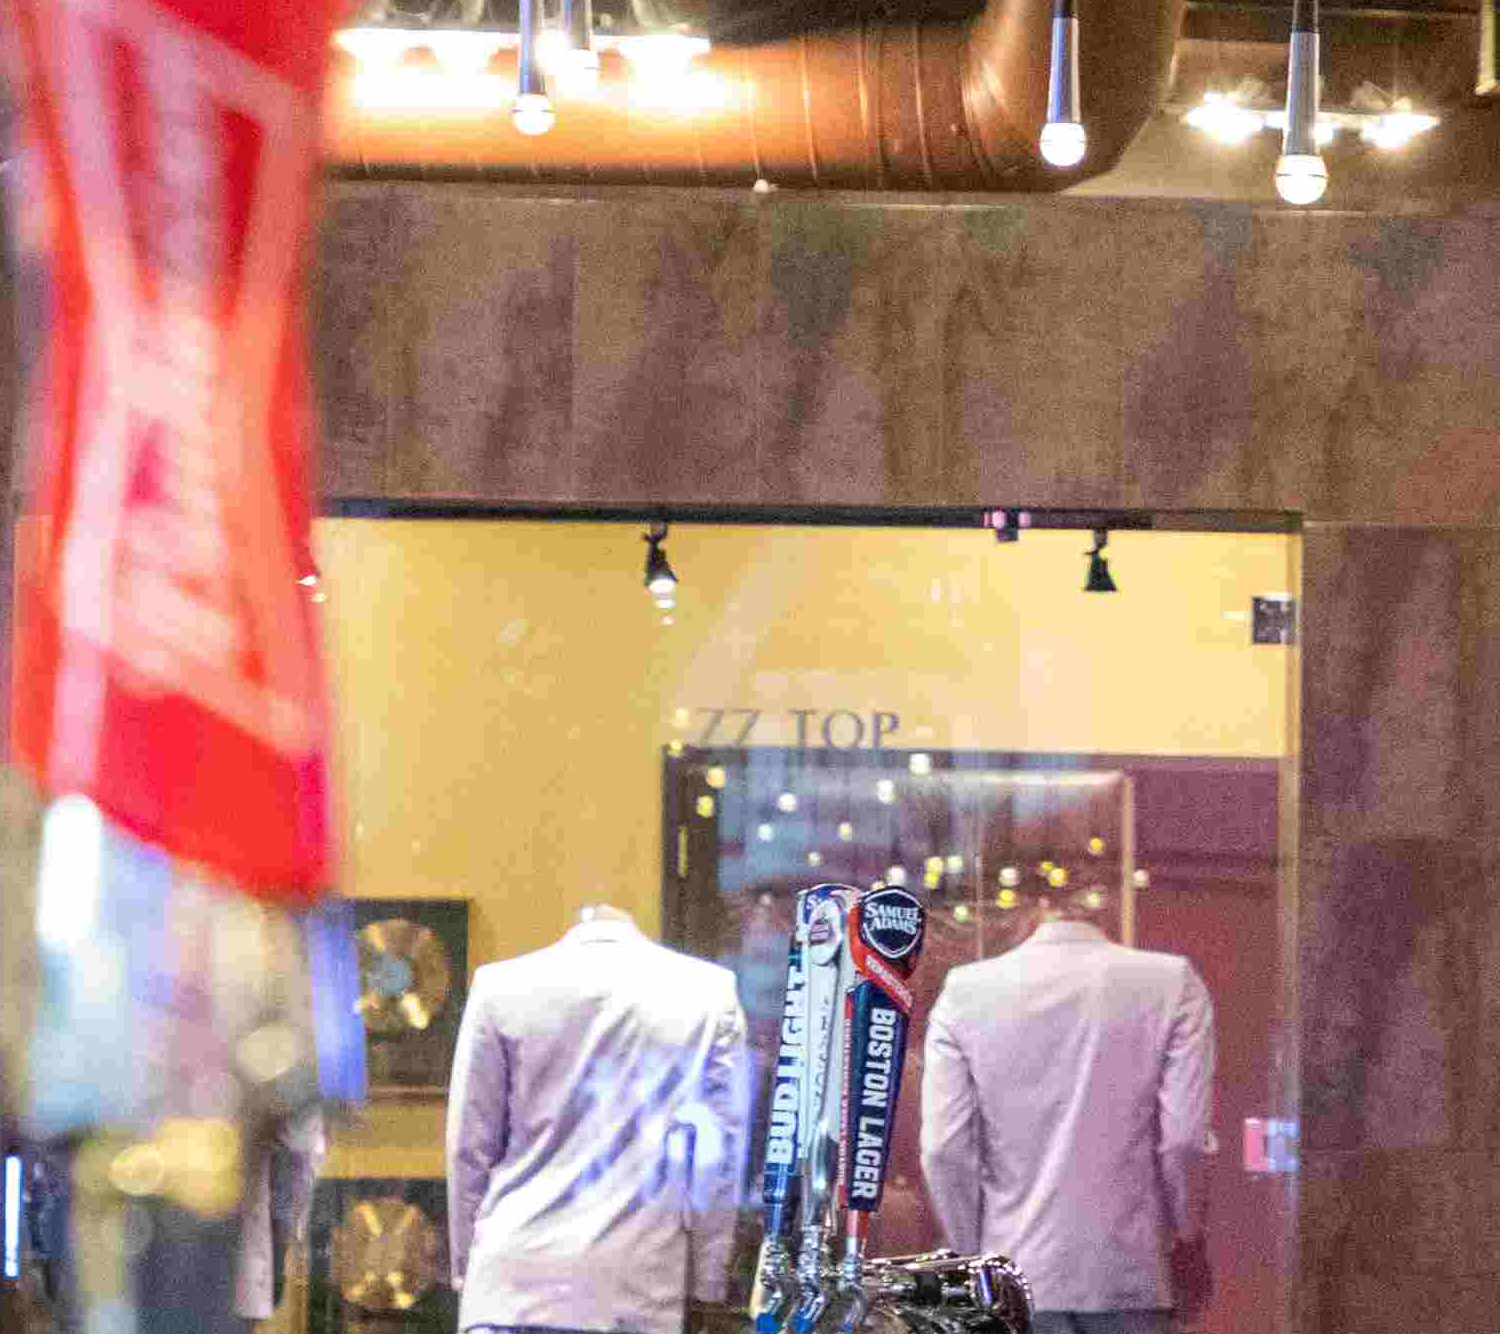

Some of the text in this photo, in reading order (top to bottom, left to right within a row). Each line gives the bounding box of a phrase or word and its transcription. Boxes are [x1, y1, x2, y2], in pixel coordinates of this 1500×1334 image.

[787, 708, 900, 749] TOP
[865, 902, 921, 923] SAMUEL
[869, 917, 917, 935] ADAMS
[861, 1007, 897, 1107] BOSTON
[767, 1082, 800, 1164] BUD
[851, 1116, 886, 1201] LAGER
